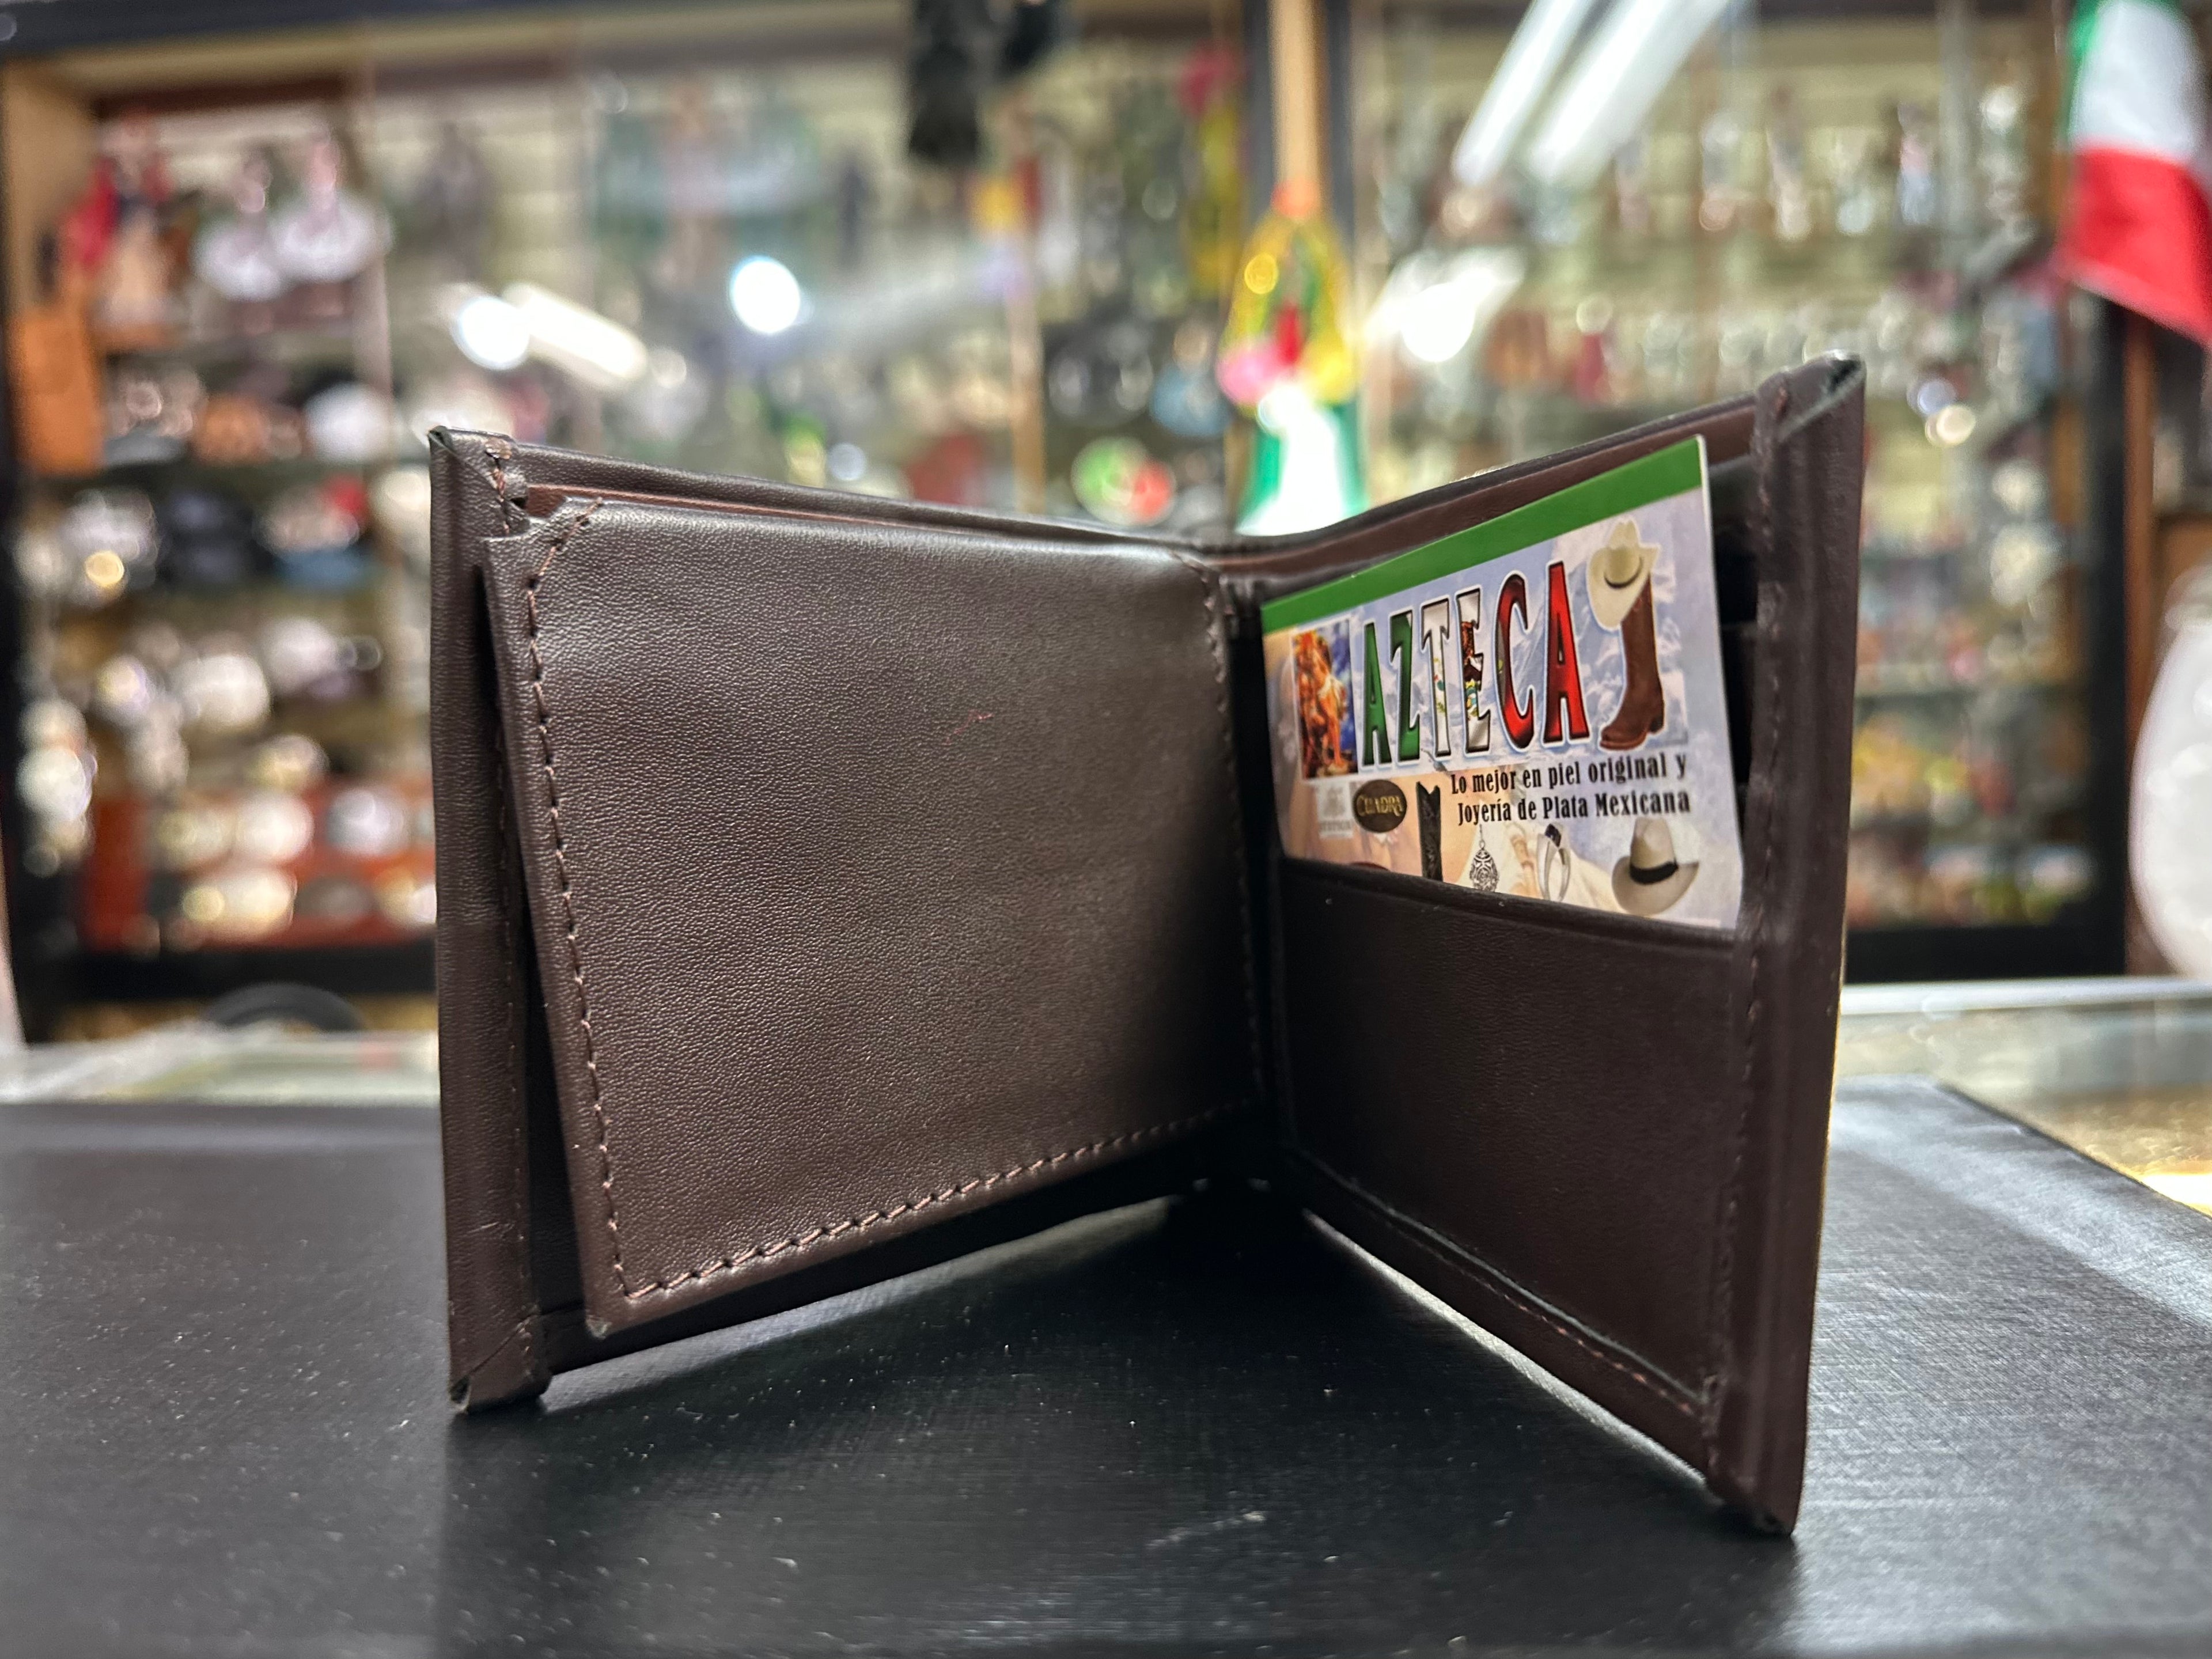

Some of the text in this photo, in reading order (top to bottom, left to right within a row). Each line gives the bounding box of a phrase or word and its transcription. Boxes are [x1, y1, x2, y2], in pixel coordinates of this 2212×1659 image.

[1362, 561, 1590, 767] AZTECA
[1451, 752, 1687, 794] Lo mejor en piel original y
[1458, 790, 1690, 825] Joyería de Plata Mexicana
